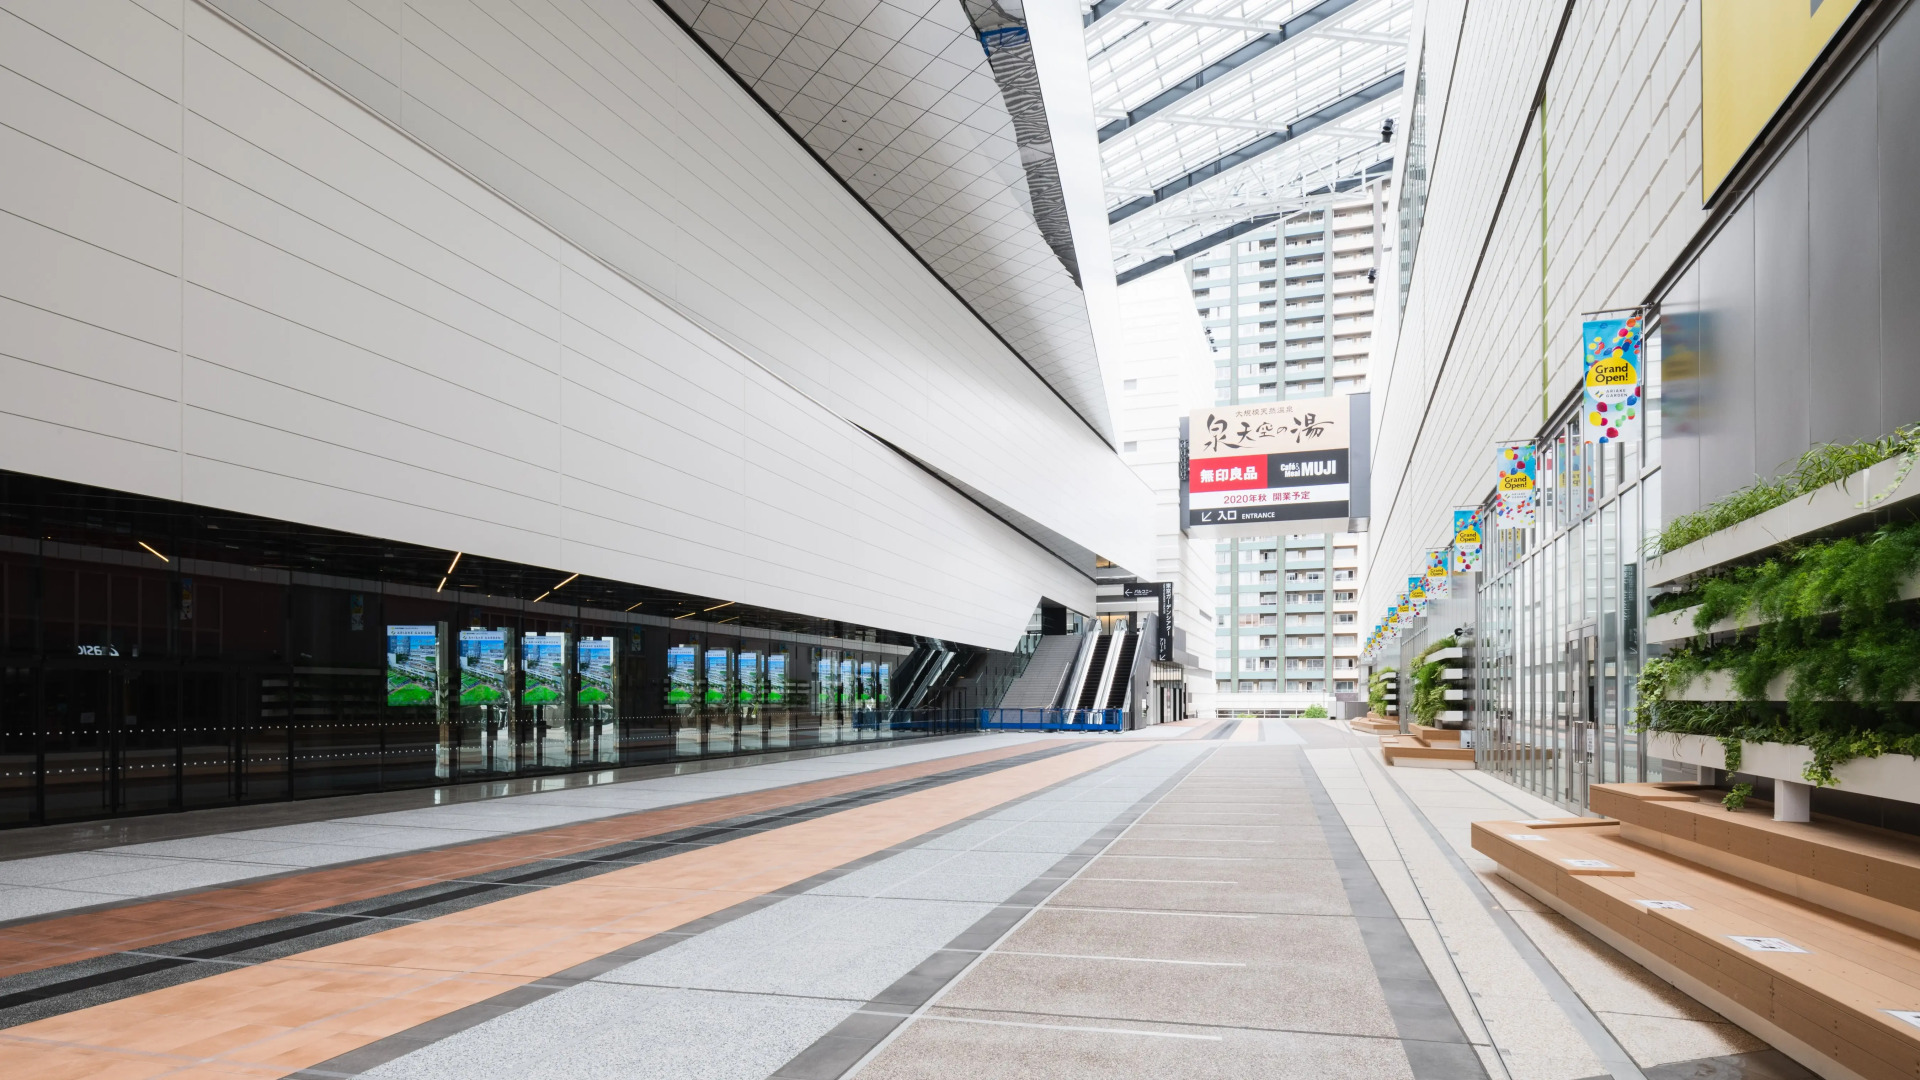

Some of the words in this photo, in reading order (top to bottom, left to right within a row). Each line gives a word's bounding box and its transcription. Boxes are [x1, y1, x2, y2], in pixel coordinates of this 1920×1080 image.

[1595, 362, 1628, 374] Grand
[1595, 372, 1628, 385] Open!
[1203, 413, 1335, 453] 泉天空の湯
[1200, 466, 1258, 483] 無印良品
[1301, 459, 1337, 477] MUJI
[1504, 475, 1527, 483] Grand
[1504, 481, 1527, 490] Open!
[1223, 493, 1267, 504] 2020年秋
[1272, 490, 1310, 502] 開業予定
[1217, 510, 1237, 521] 入口
[1241, 511, 1276, 520] ENTRANCE
